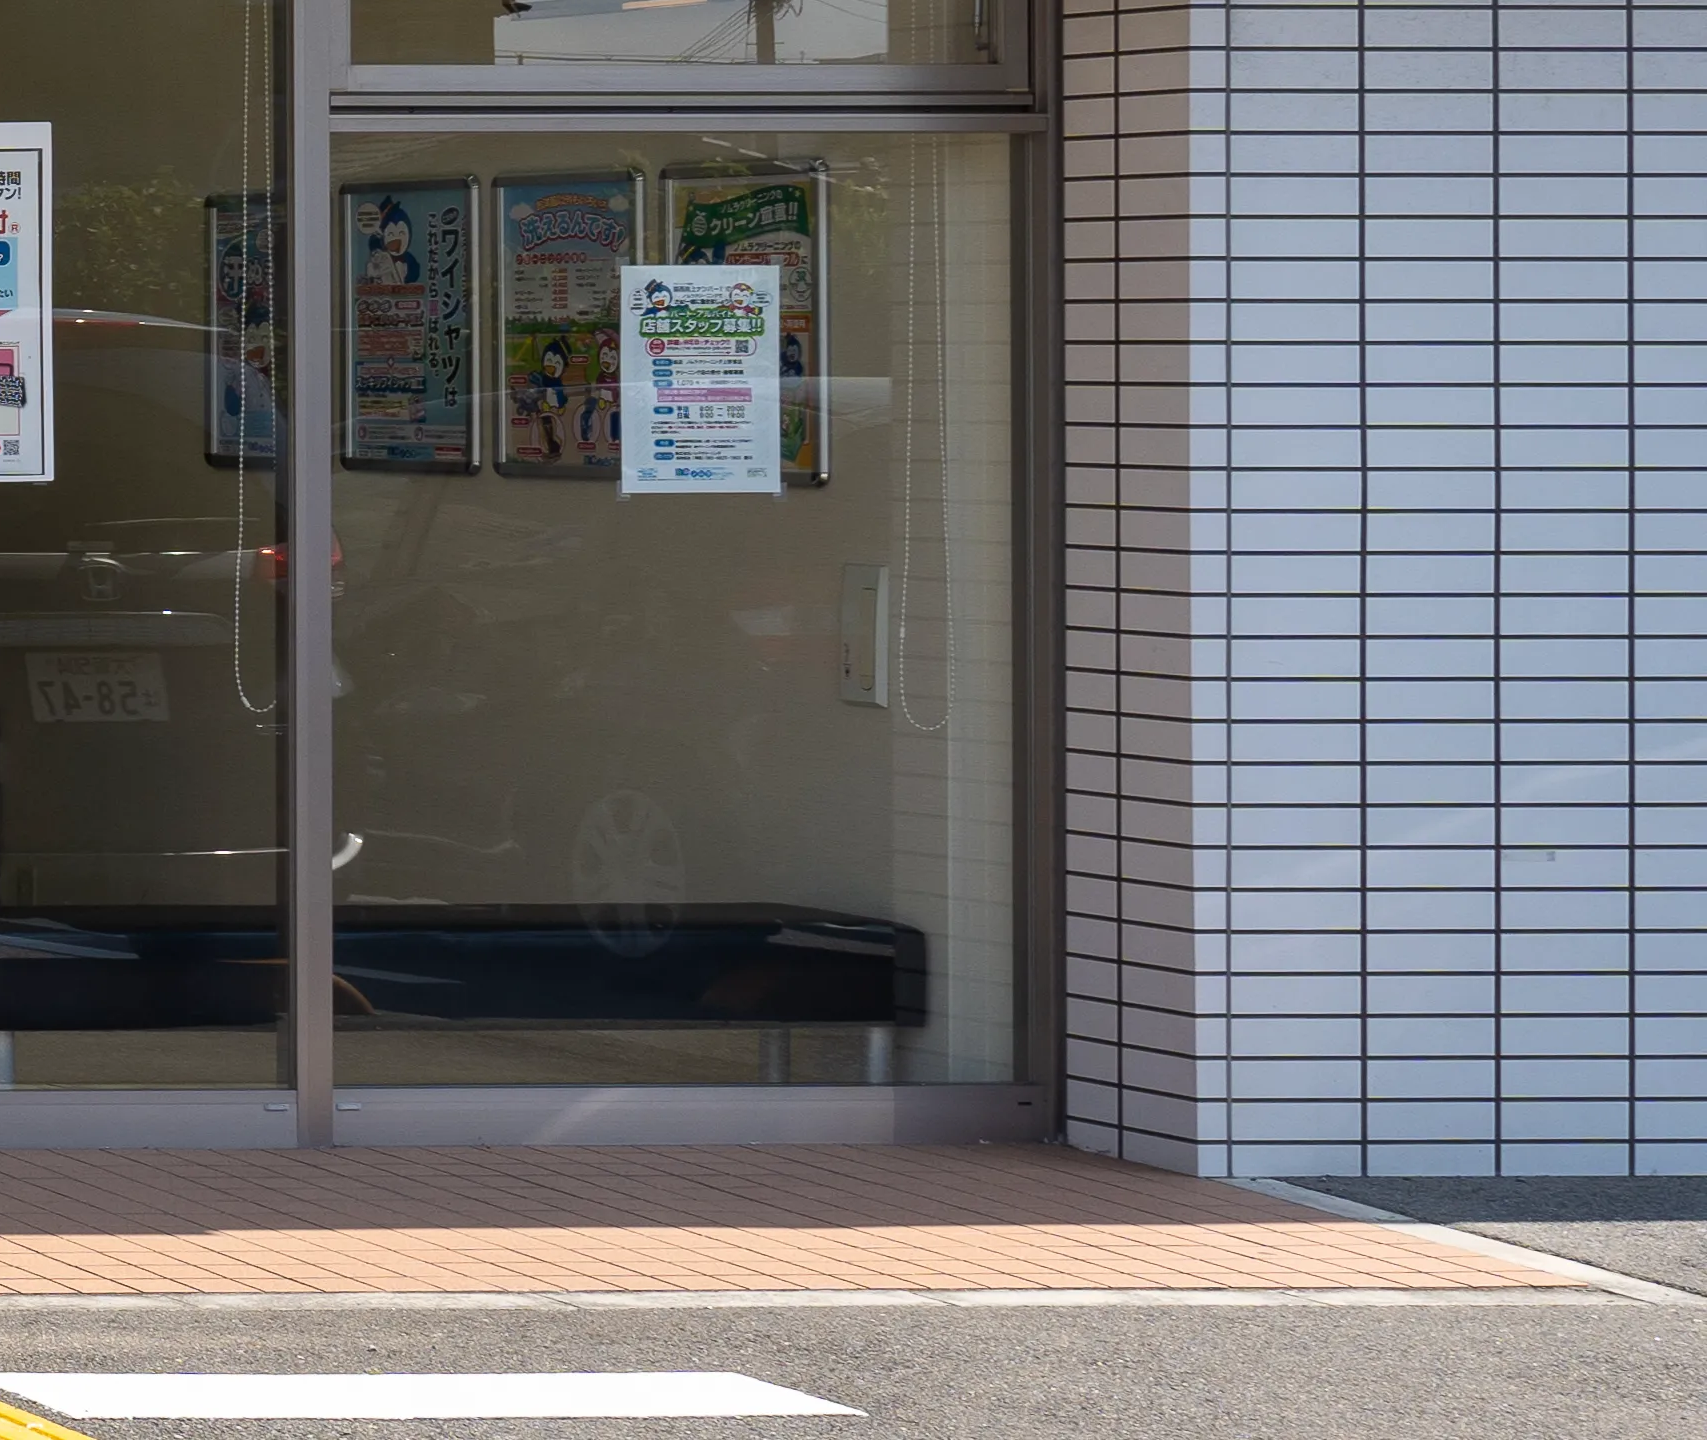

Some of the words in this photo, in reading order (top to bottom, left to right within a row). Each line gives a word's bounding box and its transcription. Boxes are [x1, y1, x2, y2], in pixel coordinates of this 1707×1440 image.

[520, 212, 627, 251] 洗えるんです!
